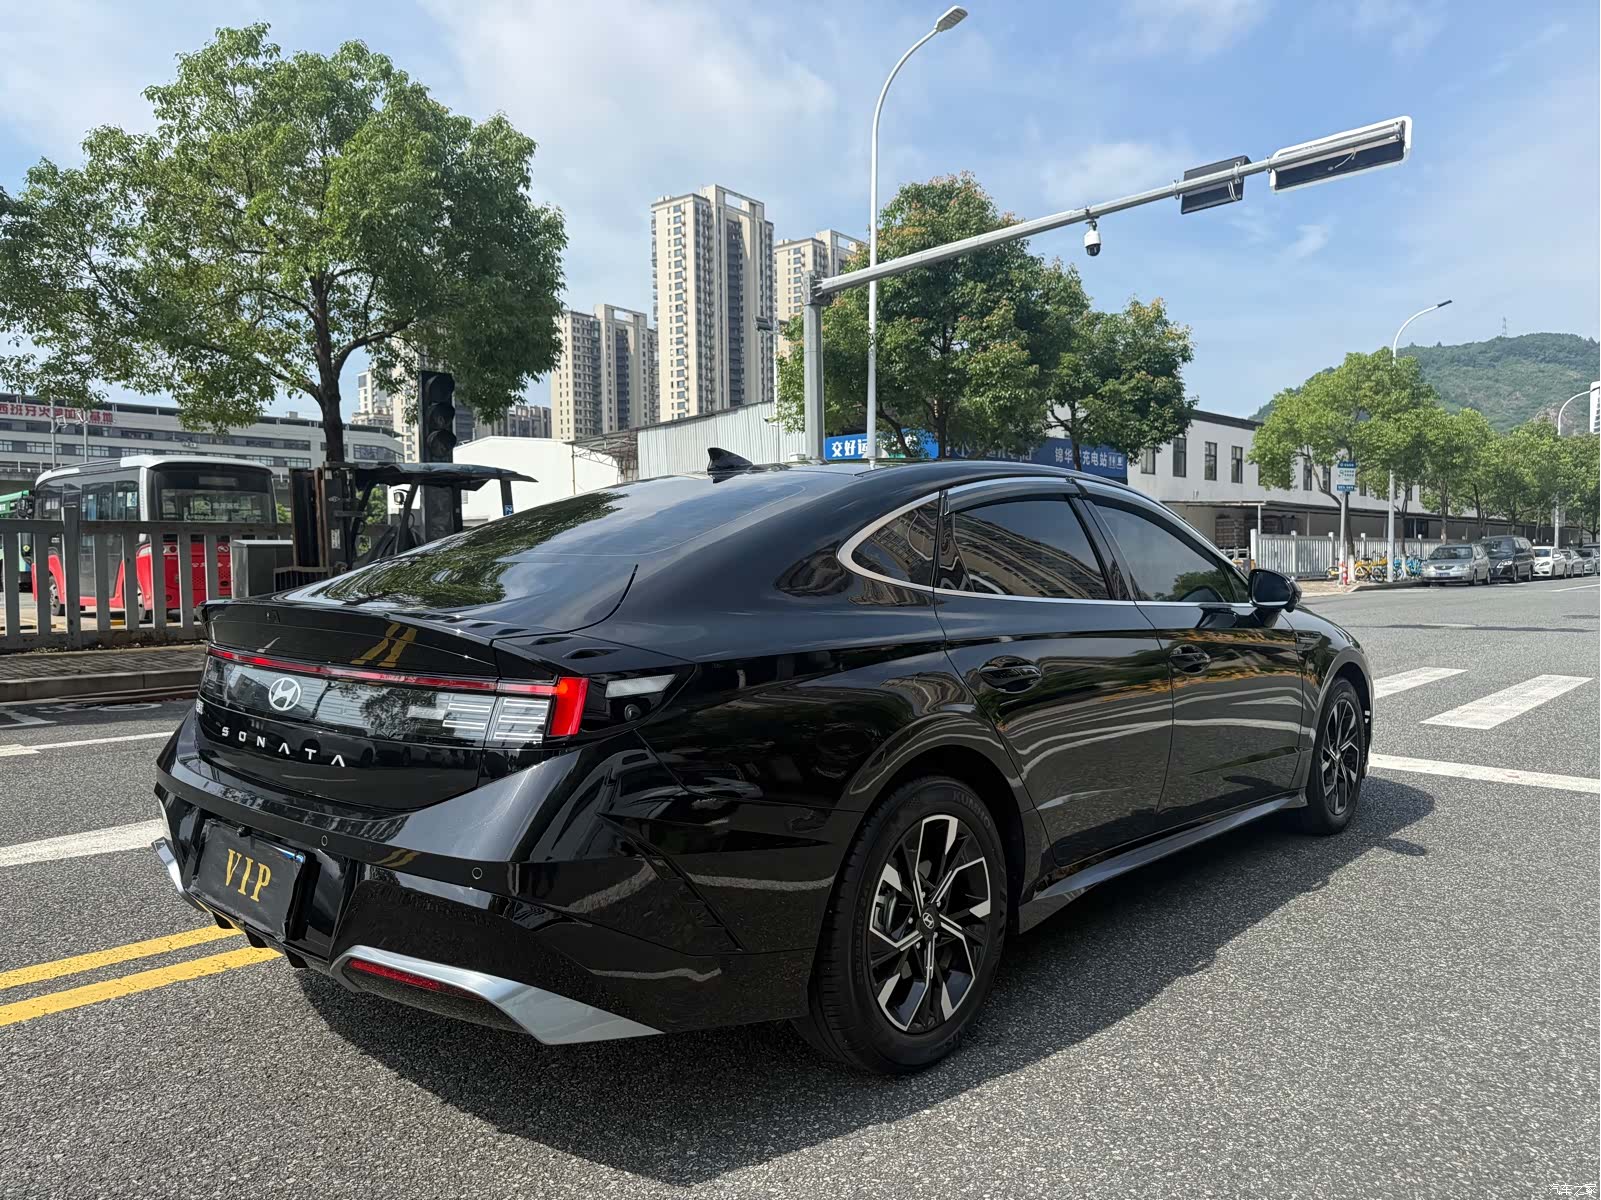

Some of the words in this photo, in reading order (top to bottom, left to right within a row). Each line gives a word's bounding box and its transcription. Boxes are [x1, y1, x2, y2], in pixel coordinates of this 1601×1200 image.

[1055, 446, 1107, 468] 锦华充电站
[221, 726, 346, 768] SONATA
[952, 791, 992, 829] KUMHO
[225, 848, 272, 903] VIP
